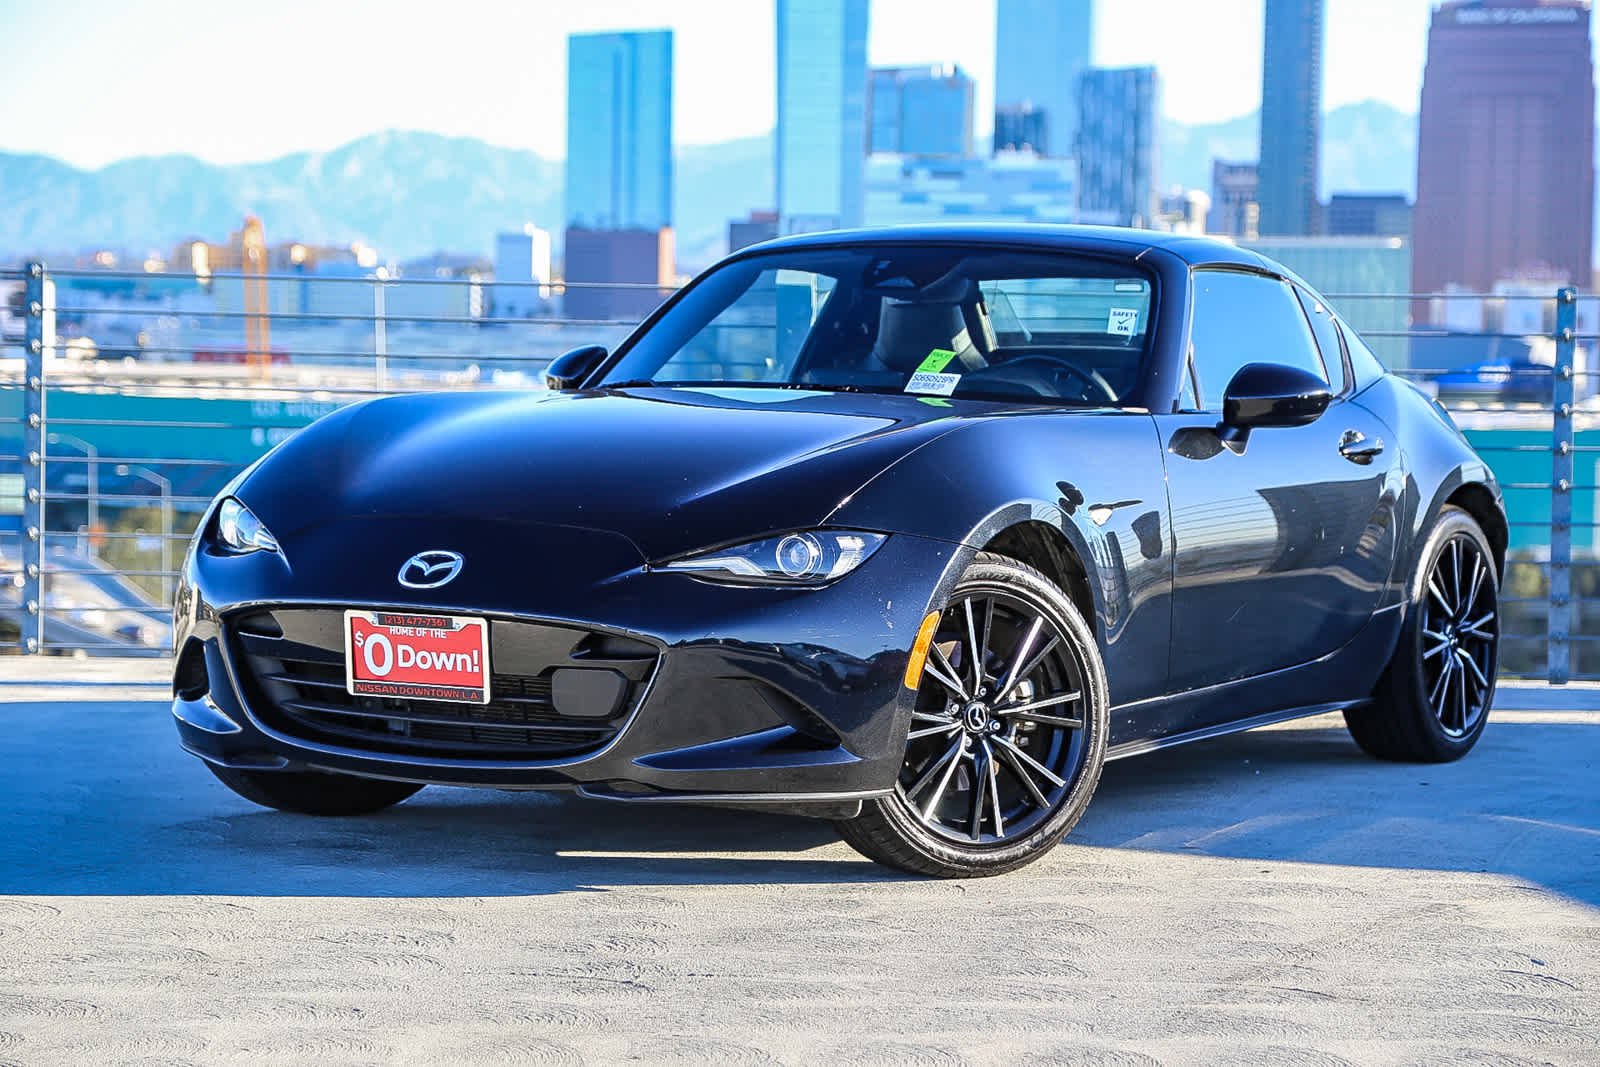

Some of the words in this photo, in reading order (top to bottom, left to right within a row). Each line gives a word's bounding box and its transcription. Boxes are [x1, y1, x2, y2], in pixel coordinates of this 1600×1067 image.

[384, 614, 405, 625] (213)
[407, 616, 446, 627] 477-7361
[389, 626, 414, 637] HOME
[415, 627, 428, 637] OF
[430, 629, 447, 639] THE
[397, 644, 480, 673] Down!
[356, 683, 398, 694] NISSAN
[400, 686, 460, 698] DOWNTOWN
